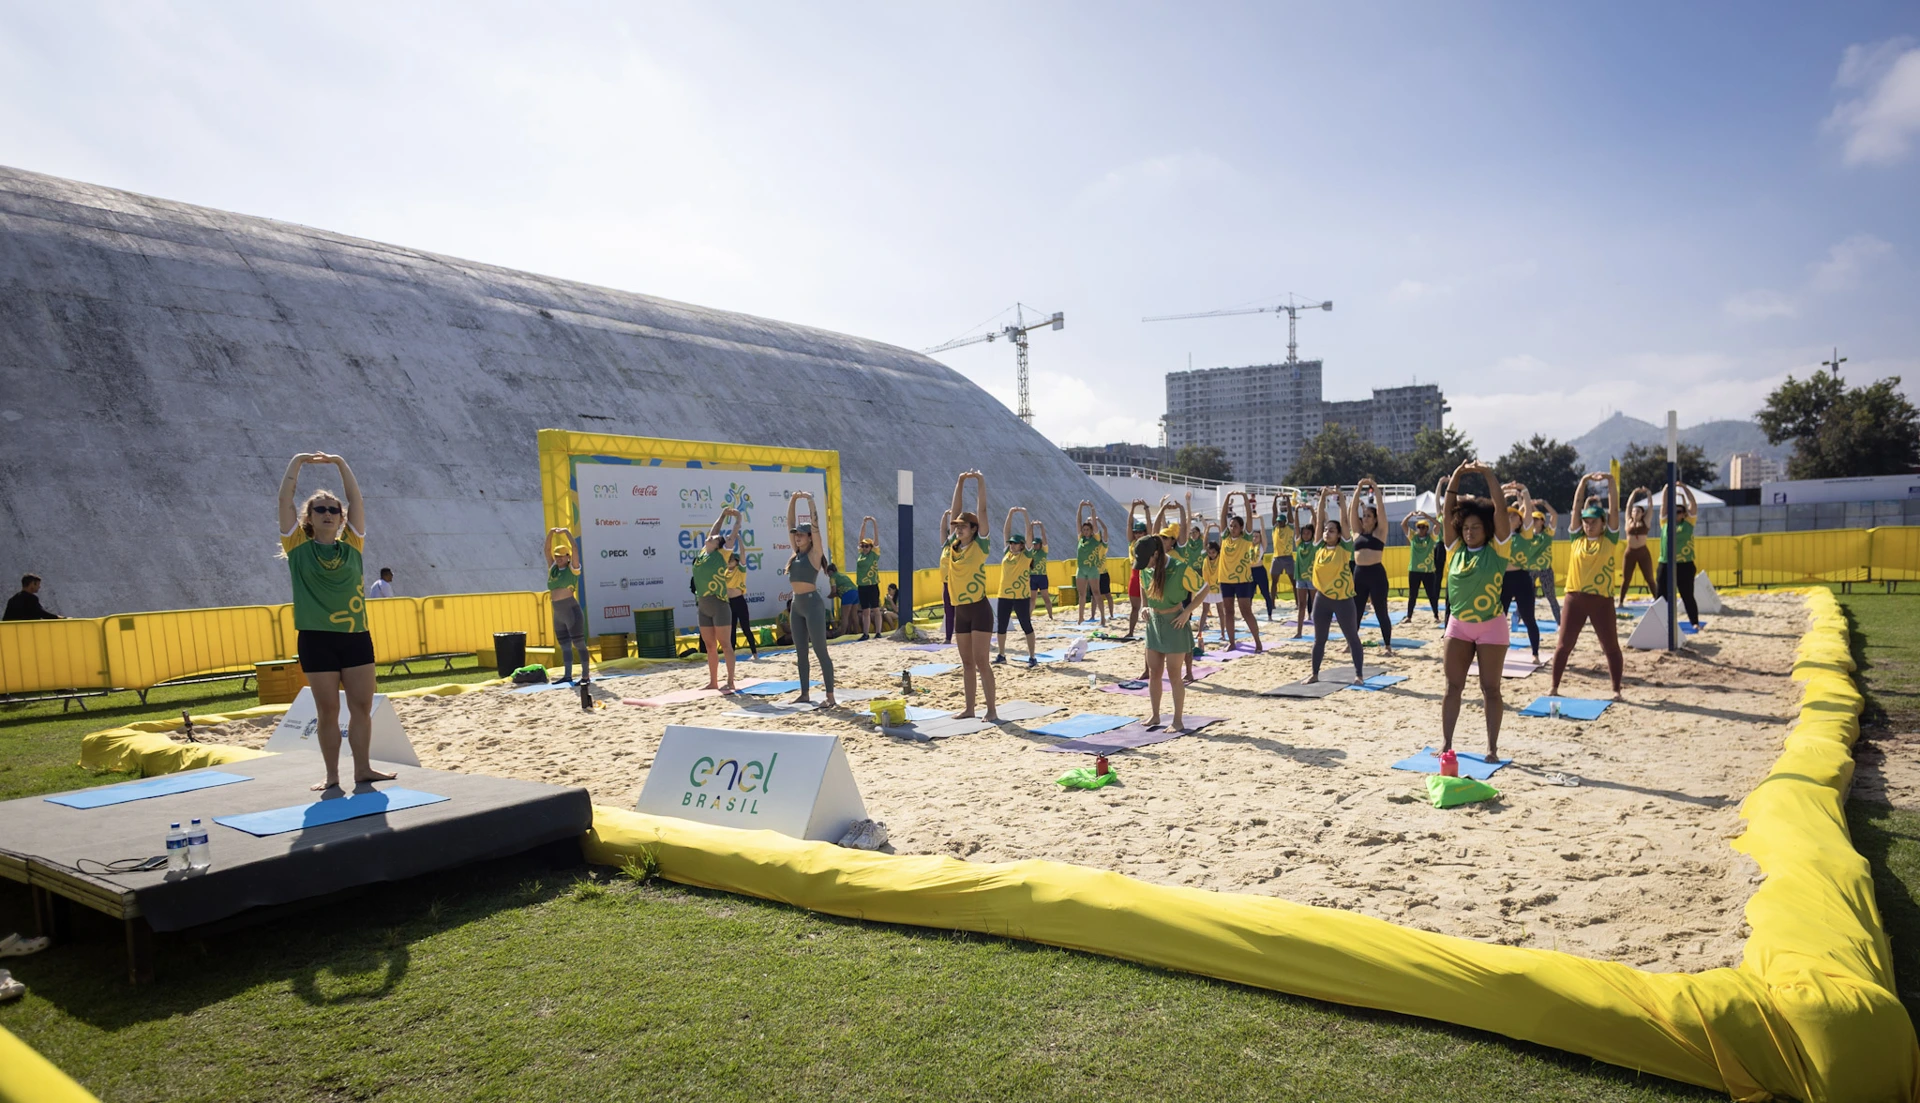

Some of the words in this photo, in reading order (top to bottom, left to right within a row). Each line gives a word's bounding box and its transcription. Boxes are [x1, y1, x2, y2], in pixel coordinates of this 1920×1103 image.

[593, 482, 618, 493] enel
[679, 485, 713, 501] enel
[689, 752, 778, 794] enel
[682, 791, 759, 814] BRASIL
